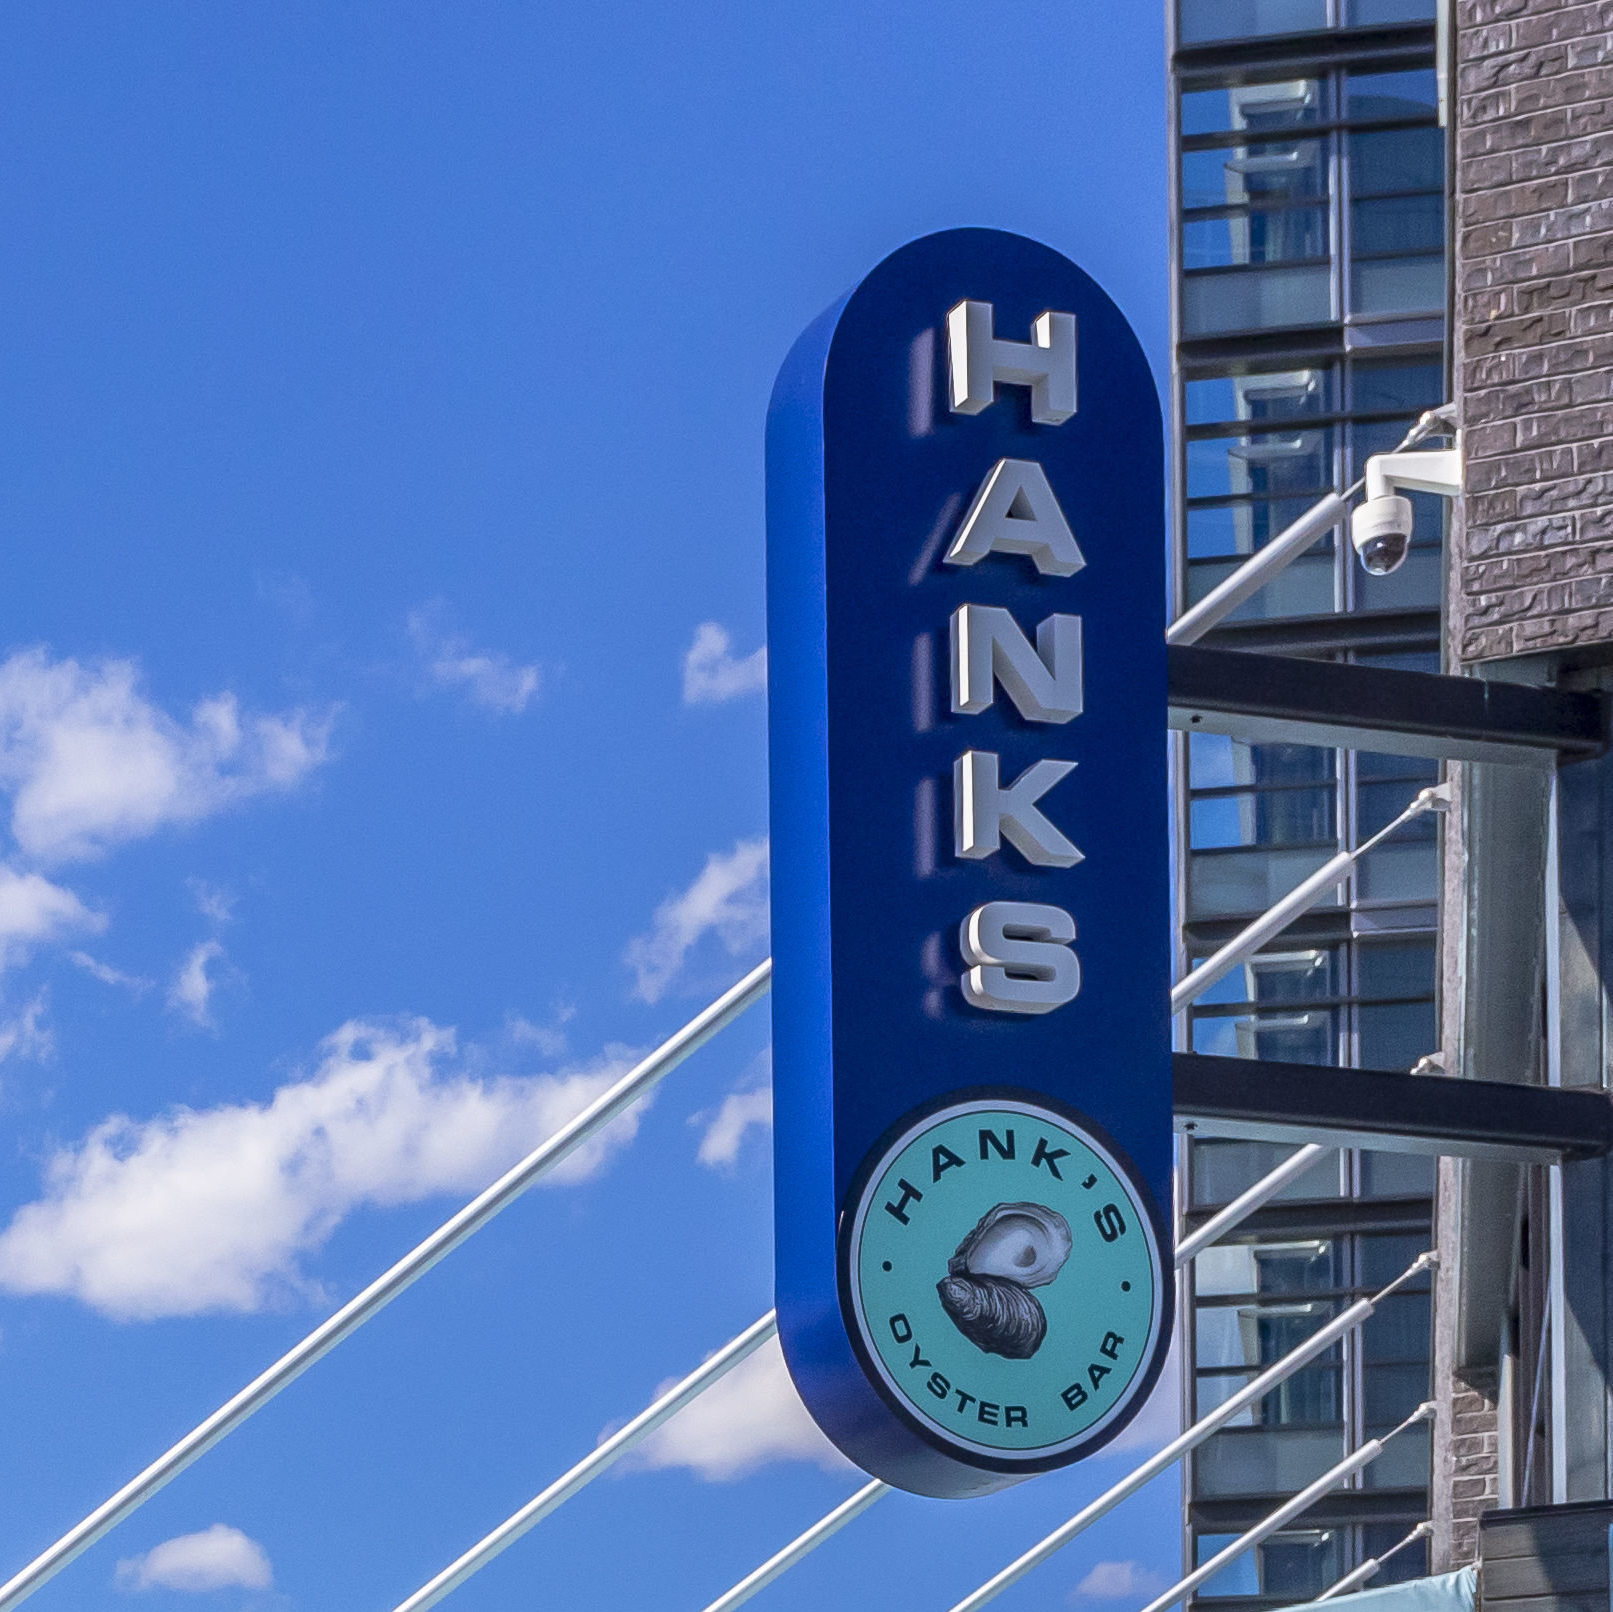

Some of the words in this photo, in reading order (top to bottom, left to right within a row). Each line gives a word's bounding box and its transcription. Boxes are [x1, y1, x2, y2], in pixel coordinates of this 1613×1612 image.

[946, 299, 1086, 1016] HANKS
[884, 1129, 1127, 1243] HANK'S
[889, 1313, 1029, 1428] OYSTER
[1060, 1331, 1125, 1412] BAR
